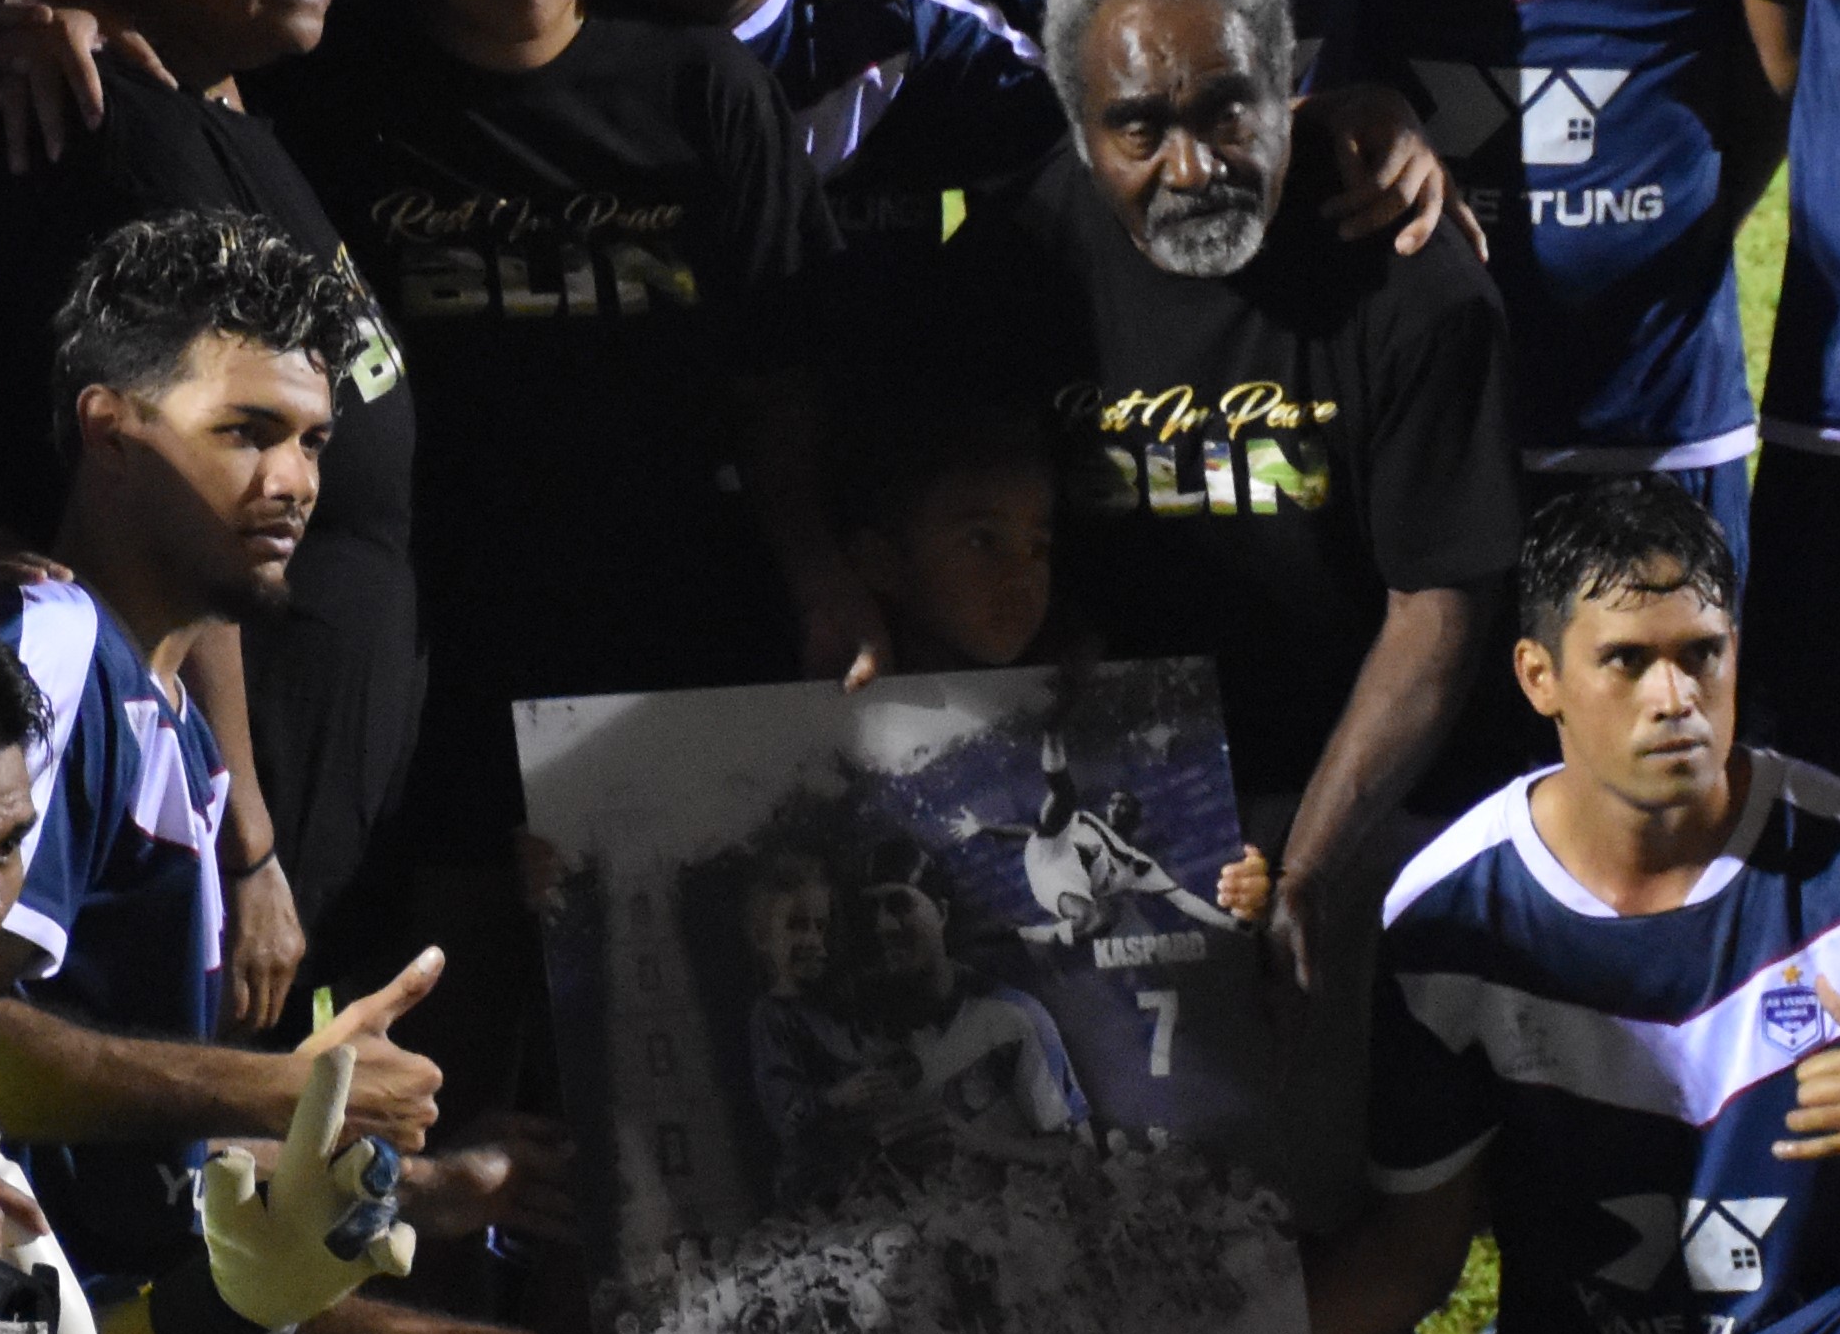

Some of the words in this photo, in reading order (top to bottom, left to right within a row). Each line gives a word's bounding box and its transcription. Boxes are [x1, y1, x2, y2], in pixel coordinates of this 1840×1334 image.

[1528, 185, 1665, 227] TUNG
[1054, 383, 1143, 433] Rst
[1135, 988, 1179, 1077] 7
